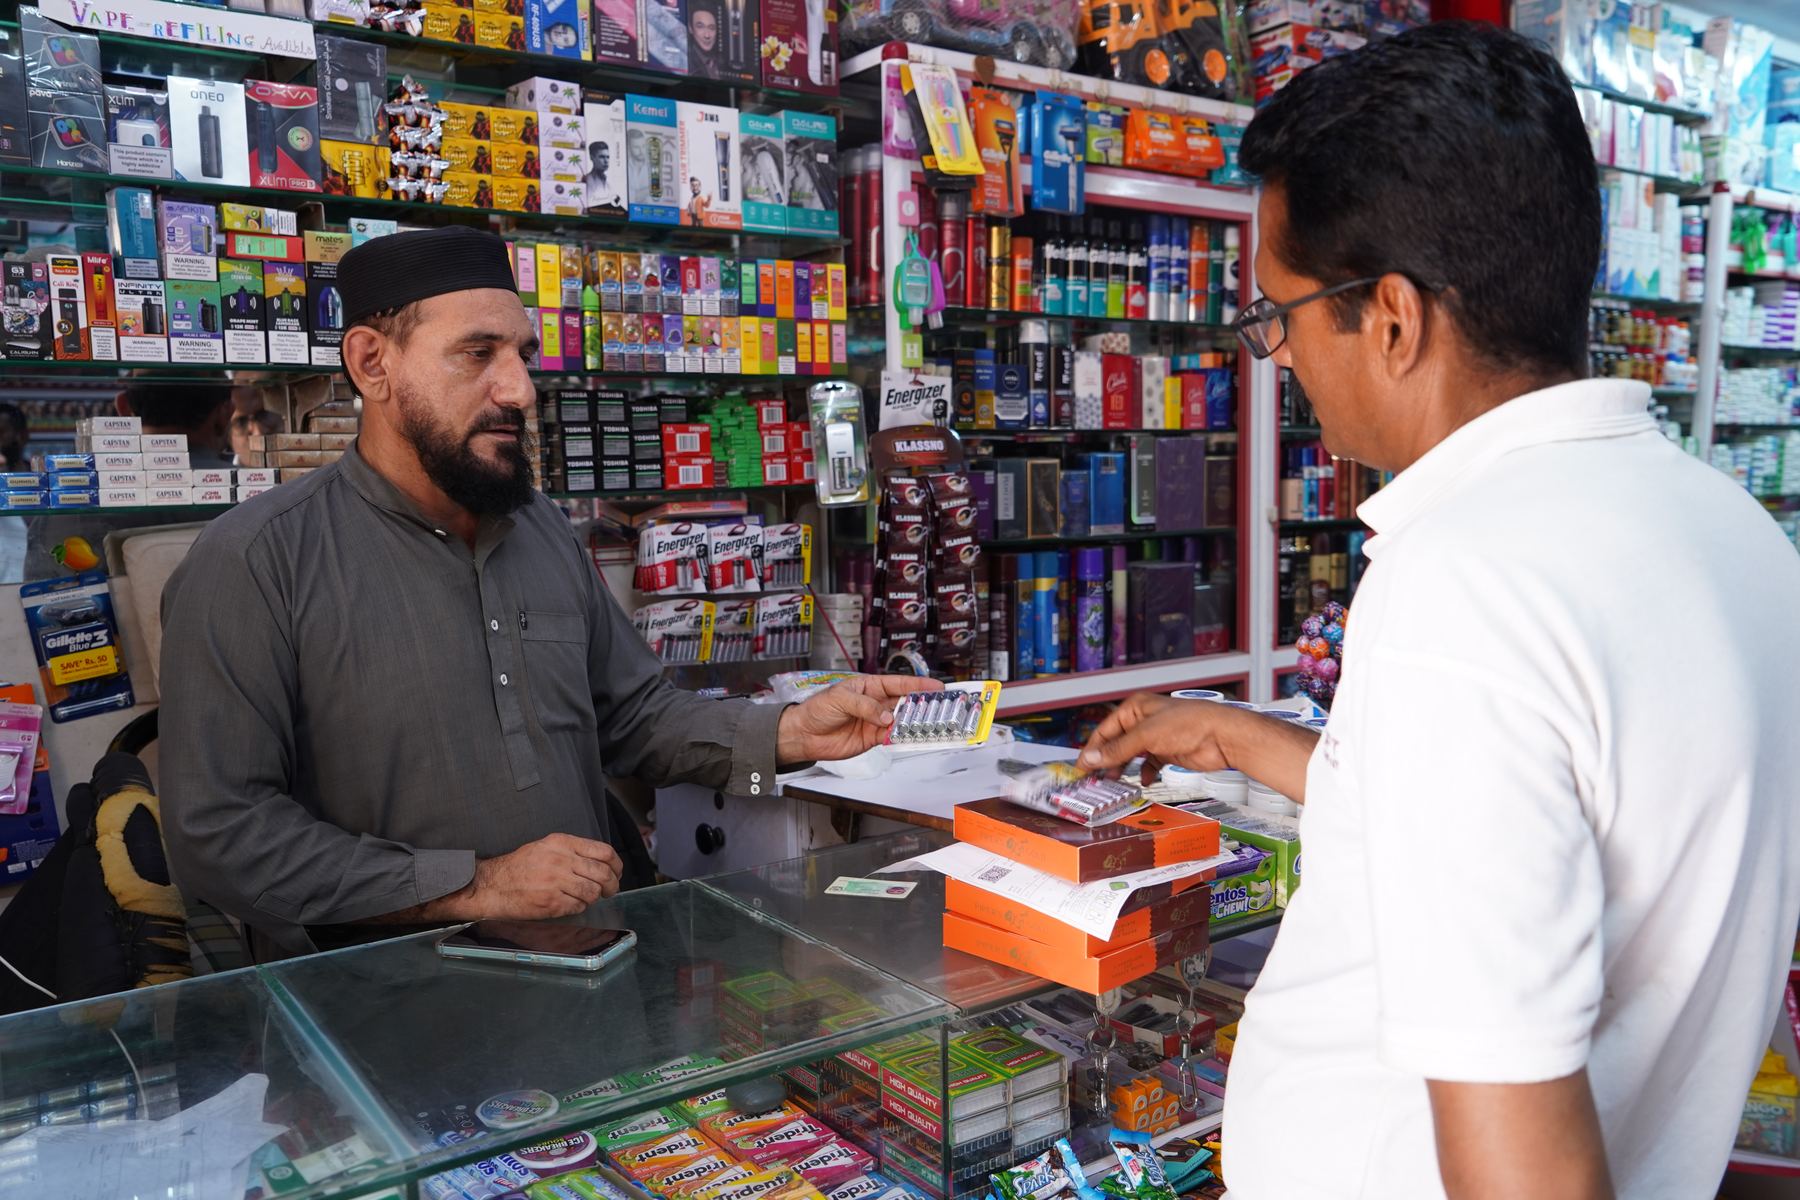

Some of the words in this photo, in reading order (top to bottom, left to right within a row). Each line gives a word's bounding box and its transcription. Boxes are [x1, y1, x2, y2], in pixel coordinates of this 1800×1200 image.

[69, 0, 134, 30] VAPE
[154, 20, 255, 46] REFILING
[256, 86, 312, 100] OXVA
[633, 103, 668, 118] Kemei
[315, 235, 344, 244] mates
[174, 257, 206, 265] WARNING:
[117, 282, 162, 290] INFINITY
[178, 340, 214, 348] WARNING:
[885, 384, 946, 406] Energizer
[104, 420, 132, 429] CAPSTAN
[102, 438, 130, 447] CAPSTAN
[150, 437, 178, 446] CAPSTAN
[894, 440, 945, 453] KLASSNO
[105, 456, 133, 465] CAPSTAN
[153, 455, 180, 464] CAPSTAN
[109, 473, 136, 482] CAPSTAN
[156, 472, 183, 481] CAPSTAN
[890, 477, 917, 485] KLASSNO
[109, 491, 136, 500] CAPSTAN
[155, 490, 183, 499] CAPSTAN
[656, 532, 706, 555] Energizer
[713, 533, 761, 555] Energizer
[765, 535, 802, 554] Energizer
[945, 536, 972, 547] KLASSNO
[938, 584, 965, 593] KLASSNO
[889, 592, 918, 600] KLASSNO
[650, 611, 688, 630] Energizer
[761, 605, 800, 623] Energizer
[940, 621, 968, 630] KLASSNO
[46, 631, 93, 649] Gillette
[69, 642, 90, 653] Blue
[91, 629, 109, 648] 3
[1210, 887, 1246, 904] entos
[1216, 896, 1250, 919] CHEW!
[889, 1076, 906, 1094] HIGH
[907, 1086, 938, 1109] QUALITY
[889, 1100, 906, 1117] HIGH
[907, 1110, 937, 1133] QUALITY
[607, 1114, 677, 1141] Trident
[569, 1135, 585, 1148] ICE
[755, 1122, 823, 1149] Trident
[520, 1139, 568, 1155] BREAKERS
[635, 1137, 706, 1163] Trident
[662, 1160, 732, 1187] Trident
[712, 1175, 789, 1200] Trident
